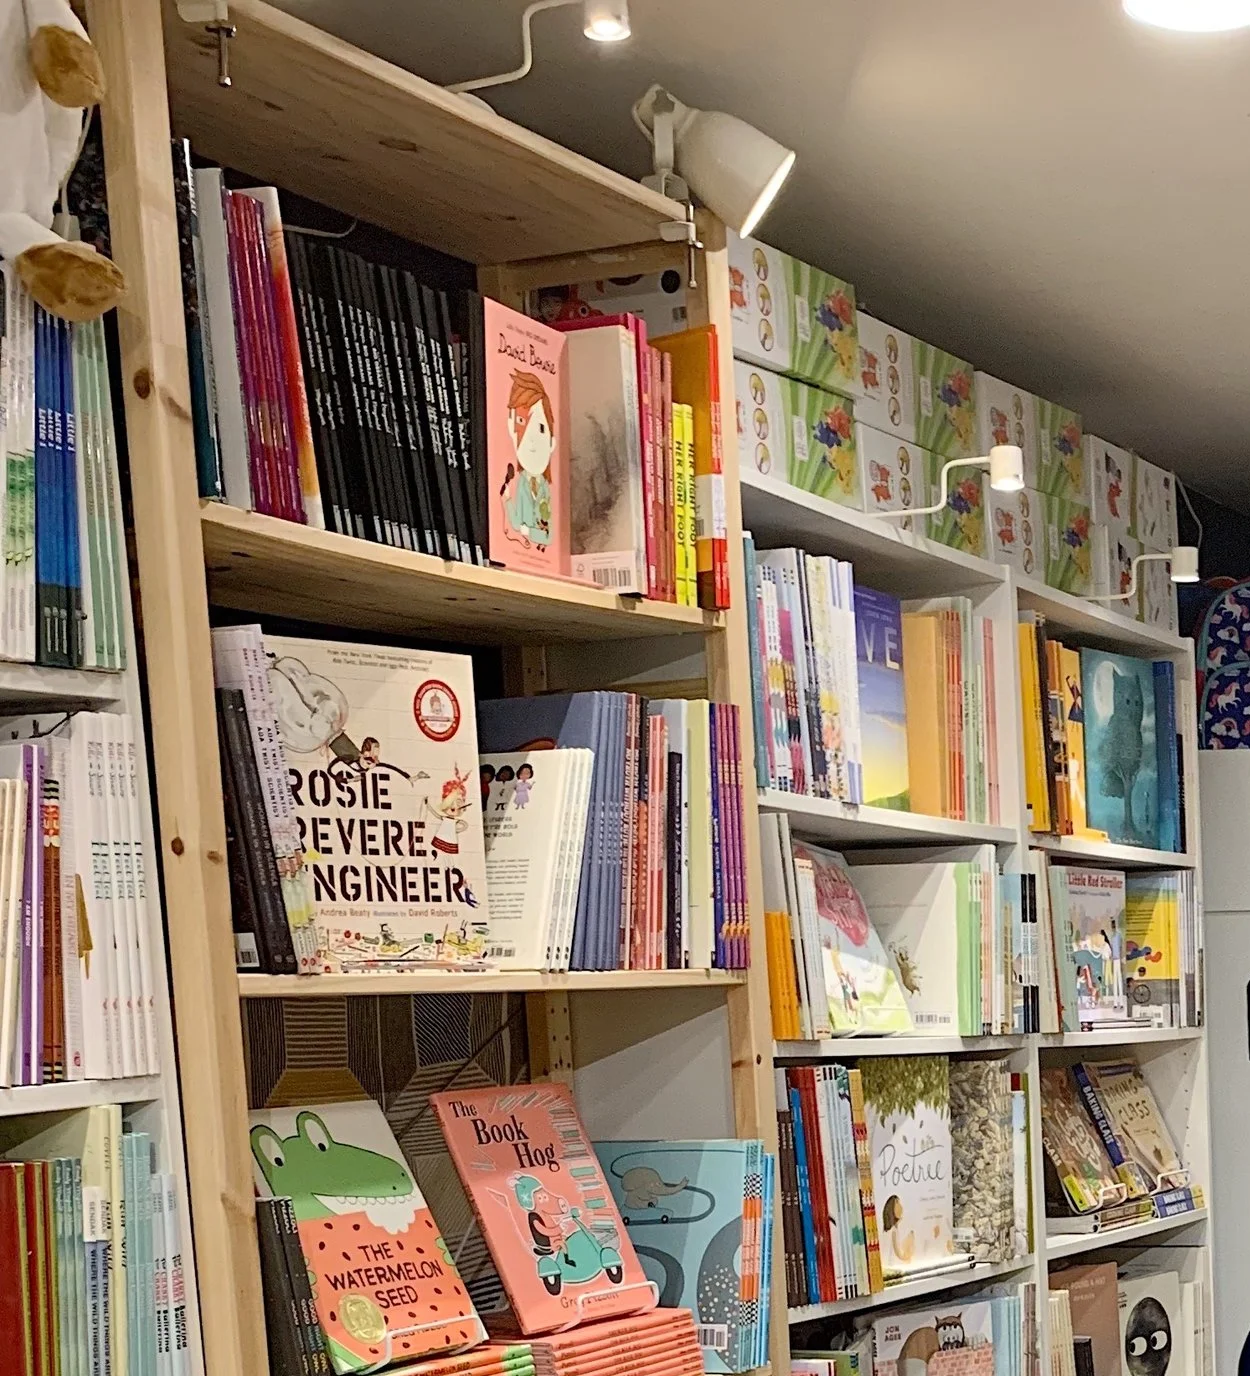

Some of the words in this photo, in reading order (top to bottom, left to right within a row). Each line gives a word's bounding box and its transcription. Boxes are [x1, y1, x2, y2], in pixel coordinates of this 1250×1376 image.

[675, 441, 683, 466] HER
[676, 473, 684, 508] RIGHT
[289, 768, 392, 810] ROSIE
[306, 864, 466, 902] NGINEER
[448, 1101, 477, 1118] The
[1082, 1086, 1103, 1120] BAKING
[471, 1115, 529, 1145] Book
[512, 1142, 560, 1172] Hog
[358, 1242, 394, 1262] THE
[324, 1259, 444, 1291] WATERMELON
[375, 1285, 418, 1309] SEED
